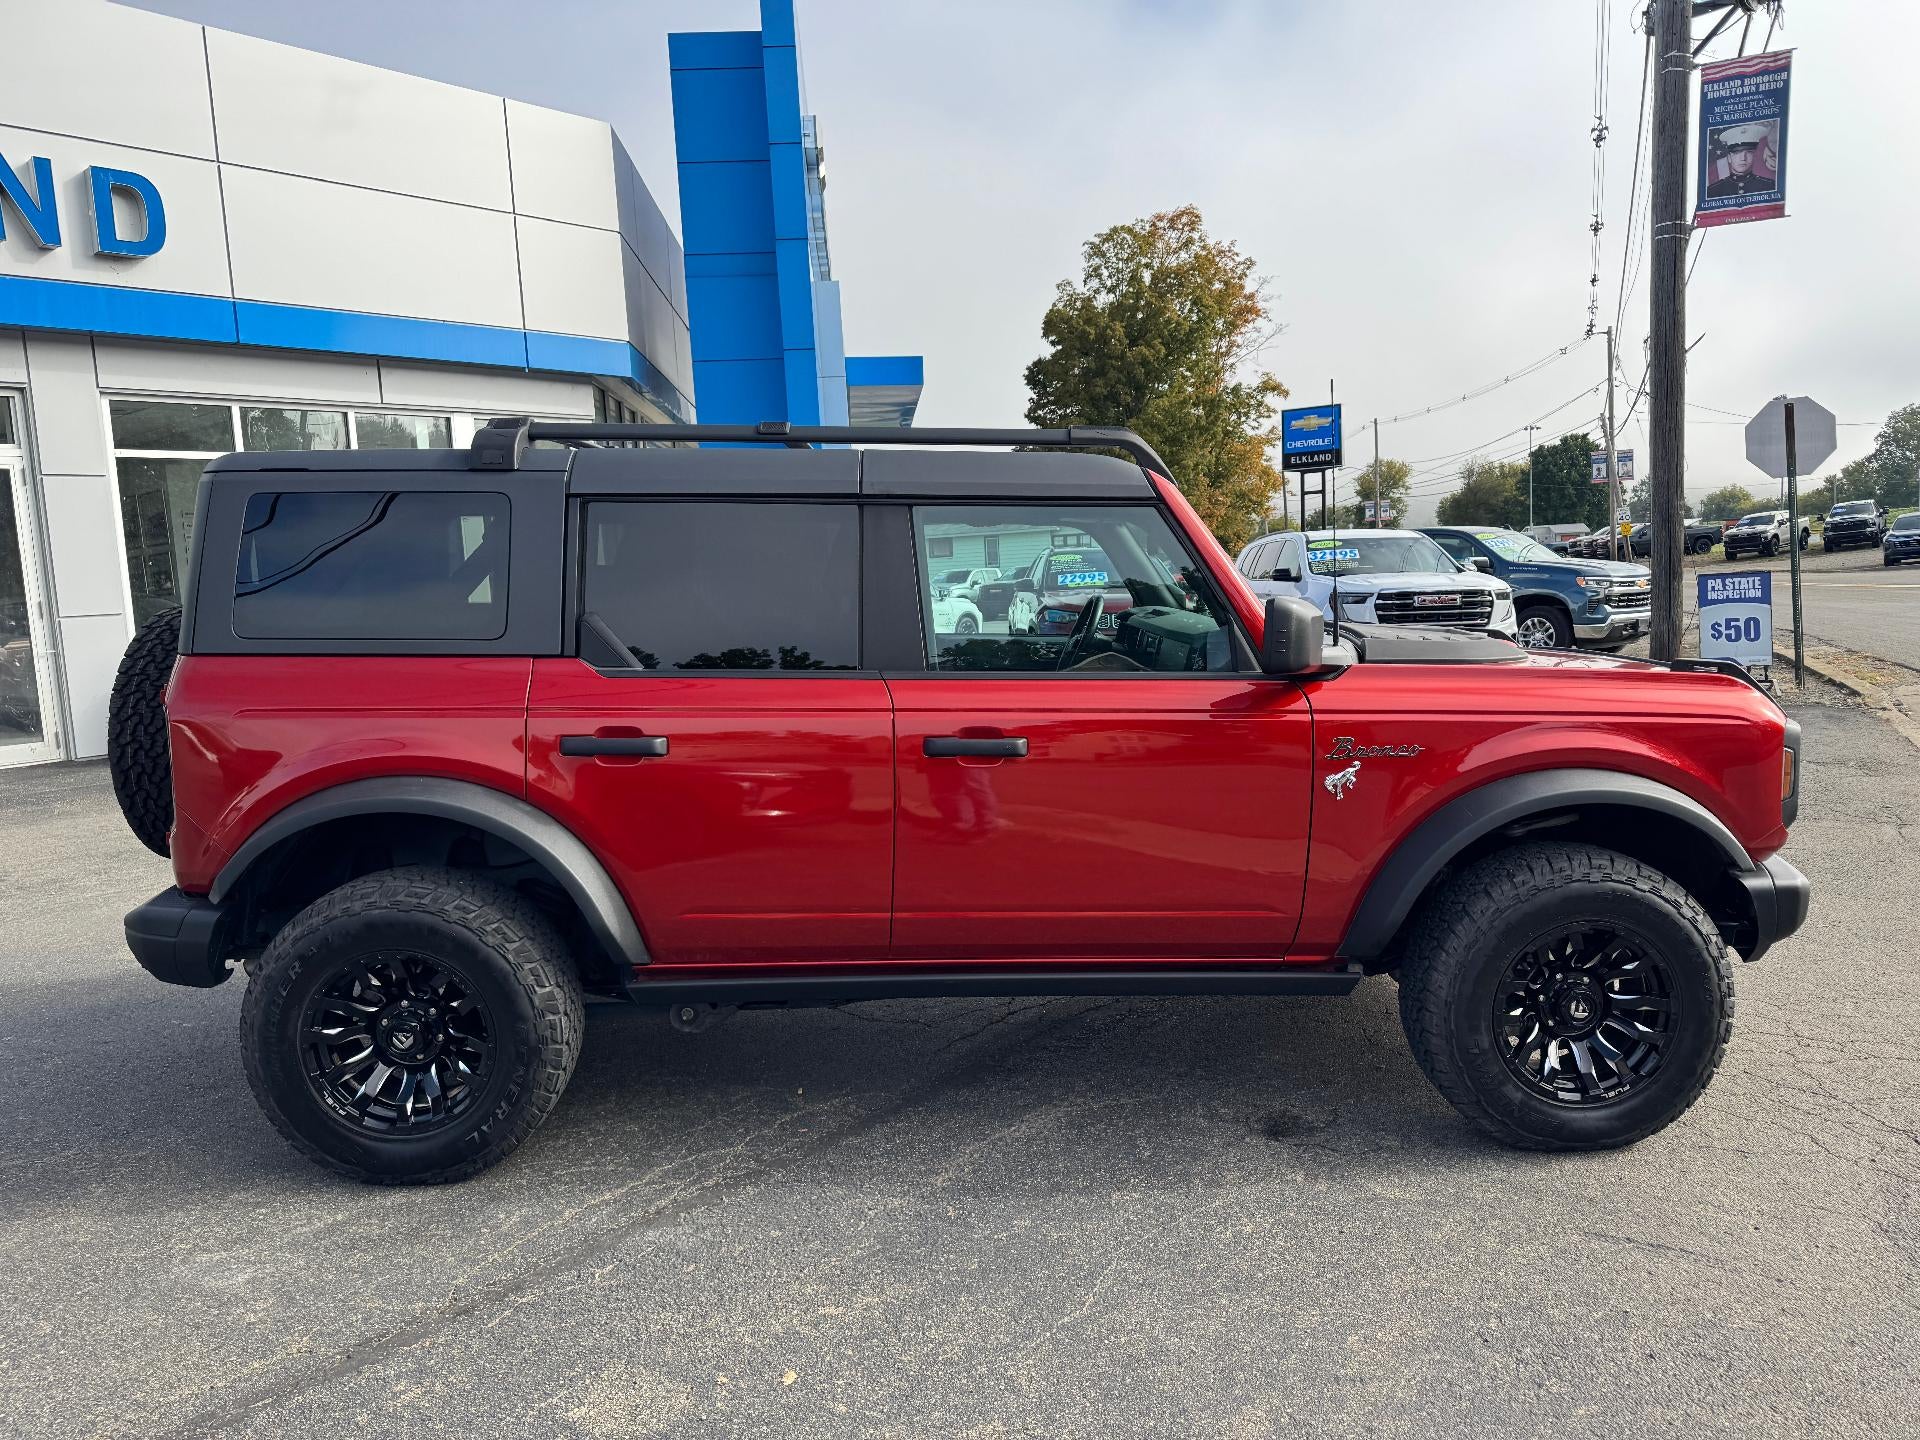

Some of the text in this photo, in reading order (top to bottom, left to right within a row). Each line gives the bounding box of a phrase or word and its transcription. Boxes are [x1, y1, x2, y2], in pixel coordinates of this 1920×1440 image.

[1703, 71, 1788, 93] ELKLAND BOROUGH
[1706, 80, 1784, 100] HOMETOWN HERO
[1714, 97, 1775, 113] MICHAEL PLANK
[1723, 111, 1754, 121] MARINE
[1754, 106, 1780, 117] CORPS
[1287, 437, 1333, 449] CHEVROLET
[1291, 453, 1332, 464] ELKLAND
[1309, 550, 1358, 561] 32995
[1059, 572, 1106, 584] 22995
[1707, 576, 1762, 591] PA STATE
[1707, 588, 1762, 600] INSPECTION
[1710, 616, 1761, 643] $50
[1325, 736, 1426, 760] Bronco
[1600, 1083, 1631, 1099] FUEL
[323, 1090, 348, 1116] FUEL
